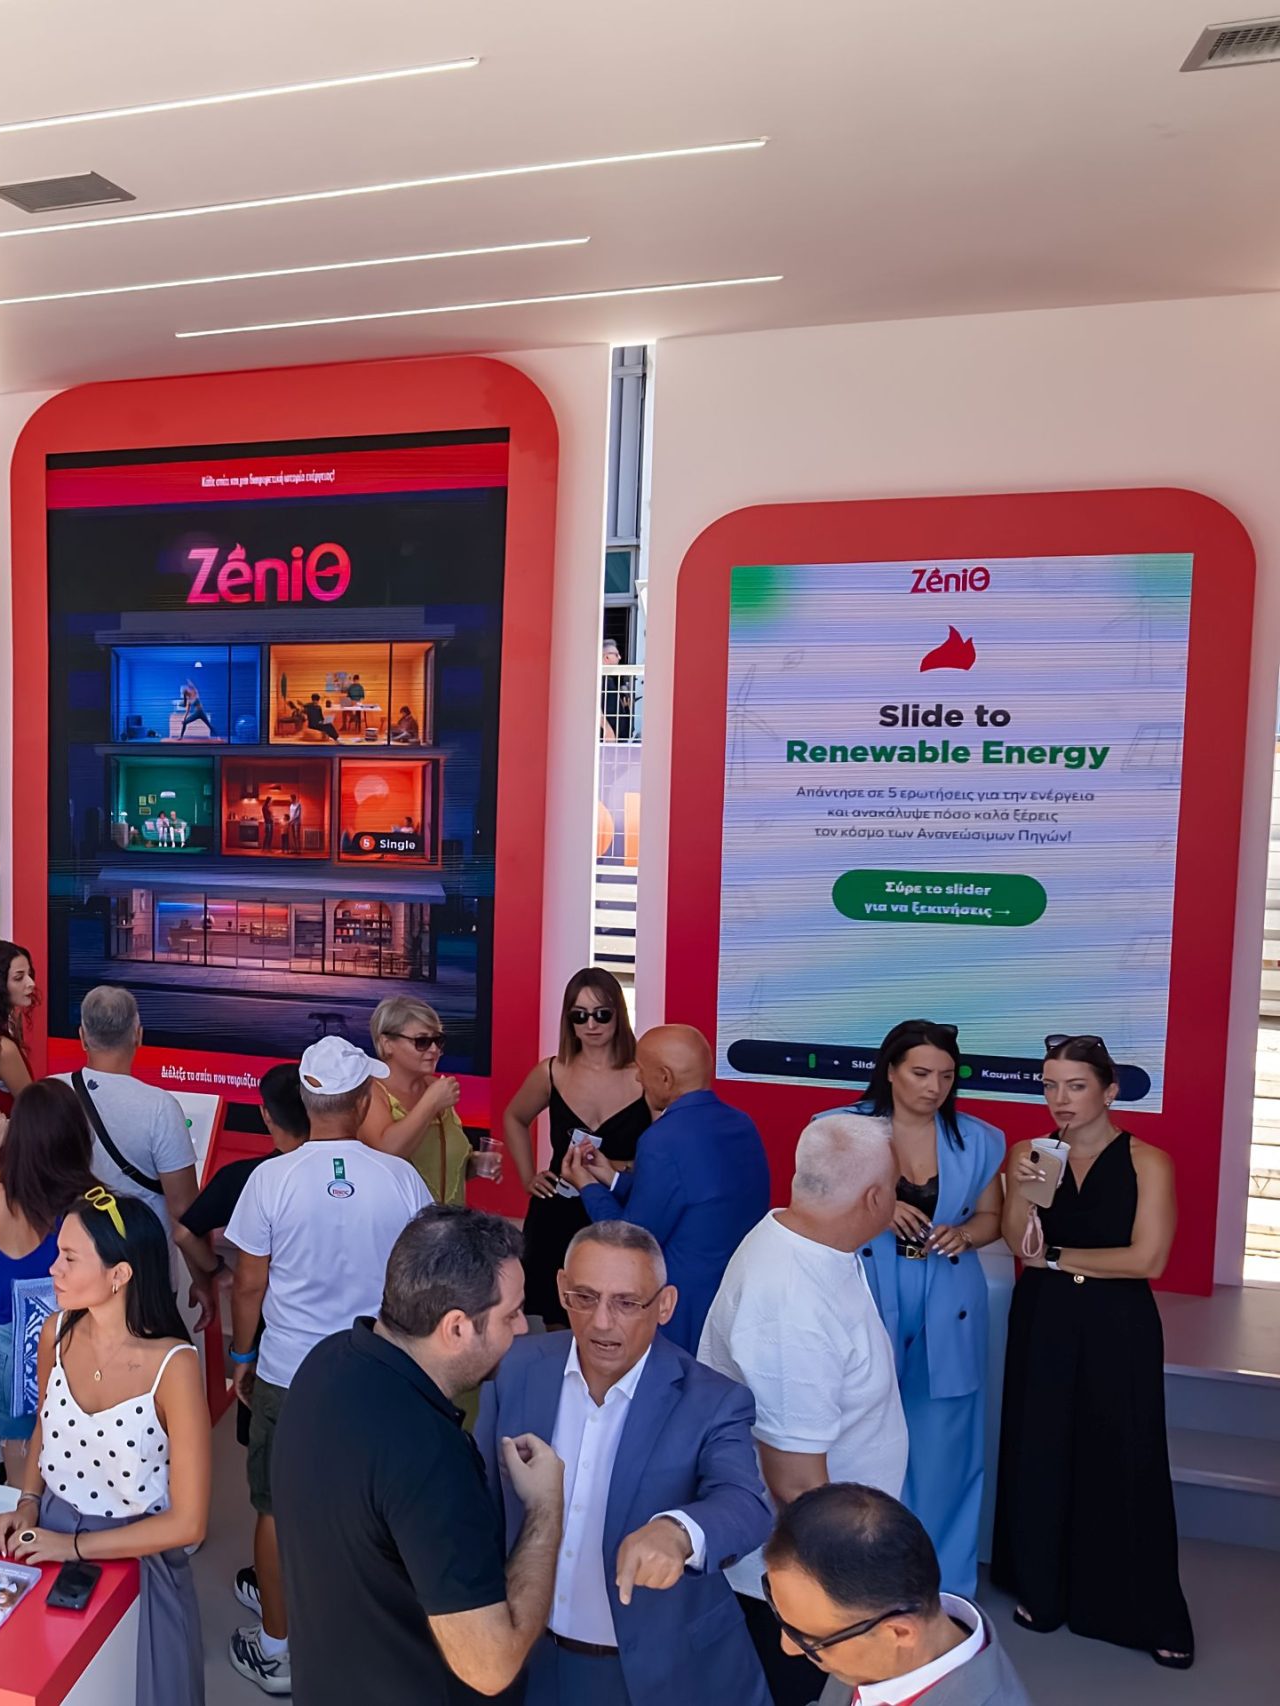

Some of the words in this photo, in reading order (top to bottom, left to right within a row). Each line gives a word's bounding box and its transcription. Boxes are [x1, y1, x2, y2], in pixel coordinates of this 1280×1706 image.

[879, 704, 964, 727] Slide
[975, 705, 1011, 727] to
[786, 740, 971, 763] Renewable
[983, 741, 1110, 769] Energy
[796, 785, 865, 799] Απάντησε
[867, 790, 885, 798] σε
[888, 787, 897, 798] 5
[900, 787, 974, 801] ερωτήσεις
[977, 791, 1000, 802] για
[1003, 791, 1027, 802] την
[1030, 788, 1095, 803] ενέργεια
[827, 808, 849, 817] και
[852, 806, 930, 820] ανακάλυψε
[933, 808, 971, 819] πόσο
[974, 809, 1010, 821] καλά
[1013, 808, 1059, 823] ξέρεις
[815, 827, 838, 837] τον
[840, 825, 884, 840] κόσμο
[888, 828, 914, 838] των
[916, 827, 1015, 842] Ανανεώσιμων
[1018, 829, 1072, 844] Πηγών!
[380, 839, 416, 851] Single
[885, 881, 922, 896] Σύρε
[925, 885, 943, 894] το
[945, 883, 992, 896] slider
[864, 902, 887, 913] για
[891, 904, 909, 913] να
[911, 901, 992, 918] ξεκινήσεις
